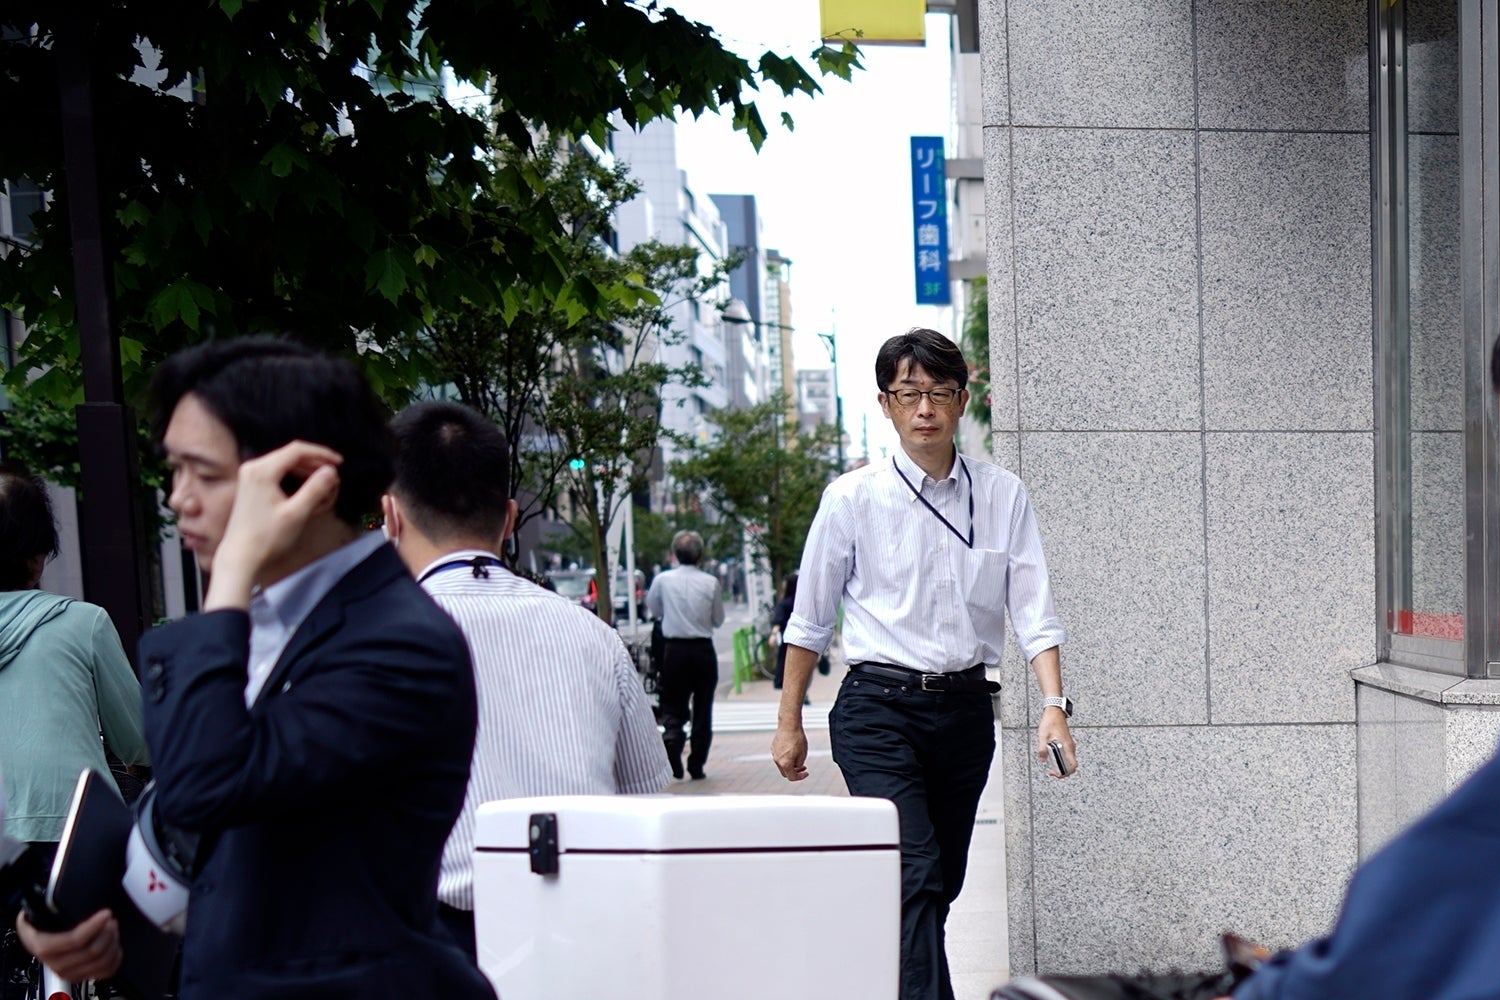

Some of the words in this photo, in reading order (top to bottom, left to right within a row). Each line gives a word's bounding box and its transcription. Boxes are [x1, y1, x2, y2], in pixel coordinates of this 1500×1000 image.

[916, 148, 941, 272] リーフ歯科
